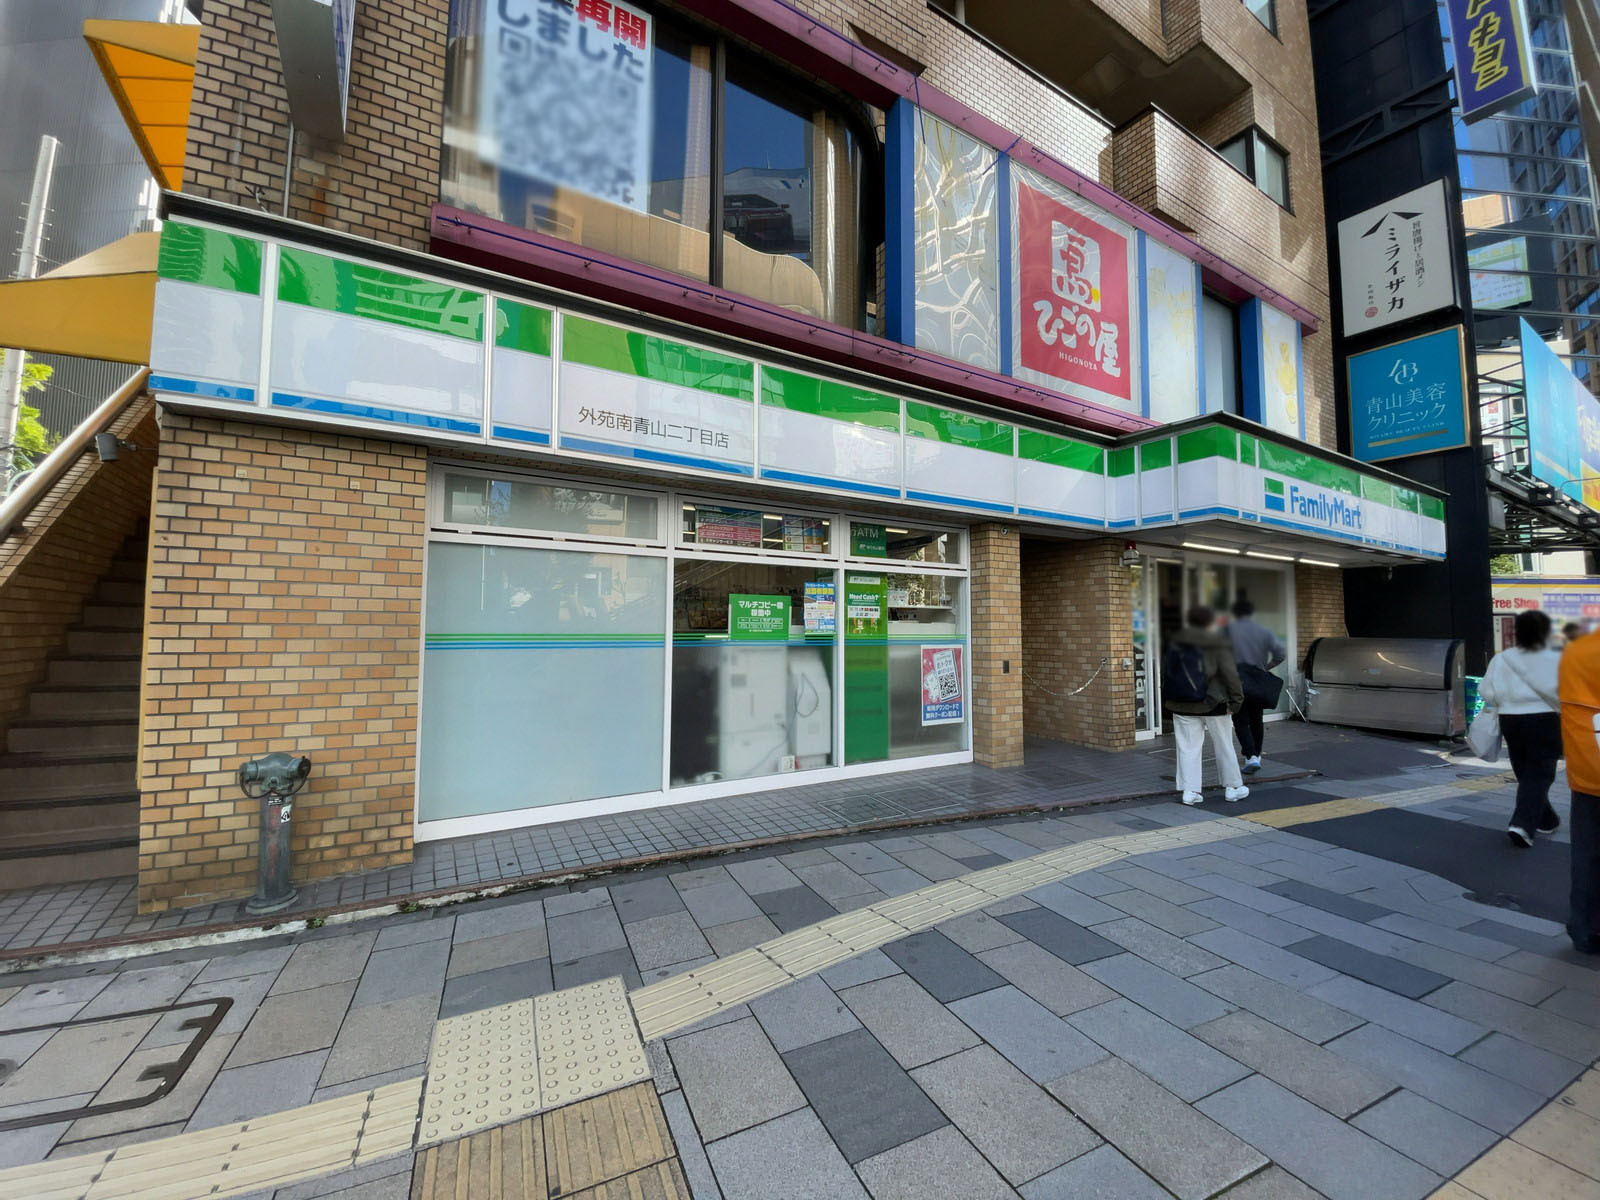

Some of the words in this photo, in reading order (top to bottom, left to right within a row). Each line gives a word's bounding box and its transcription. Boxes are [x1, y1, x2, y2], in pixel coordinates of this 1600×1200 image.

[1384, 227, 1406, 313] ミライザカ
[1033, 300, 1121, 377] ひごの屋
[1058, 351, 1098, 371] HIGONOYA
[1365, 382, 1447, 414] 青山美容
[1368, 402, 1446, 432] クリニック
[578, 406, 729, 449] 外苑南青山二丁目店
[1290, 485, 1362, 529] FamilyMart
